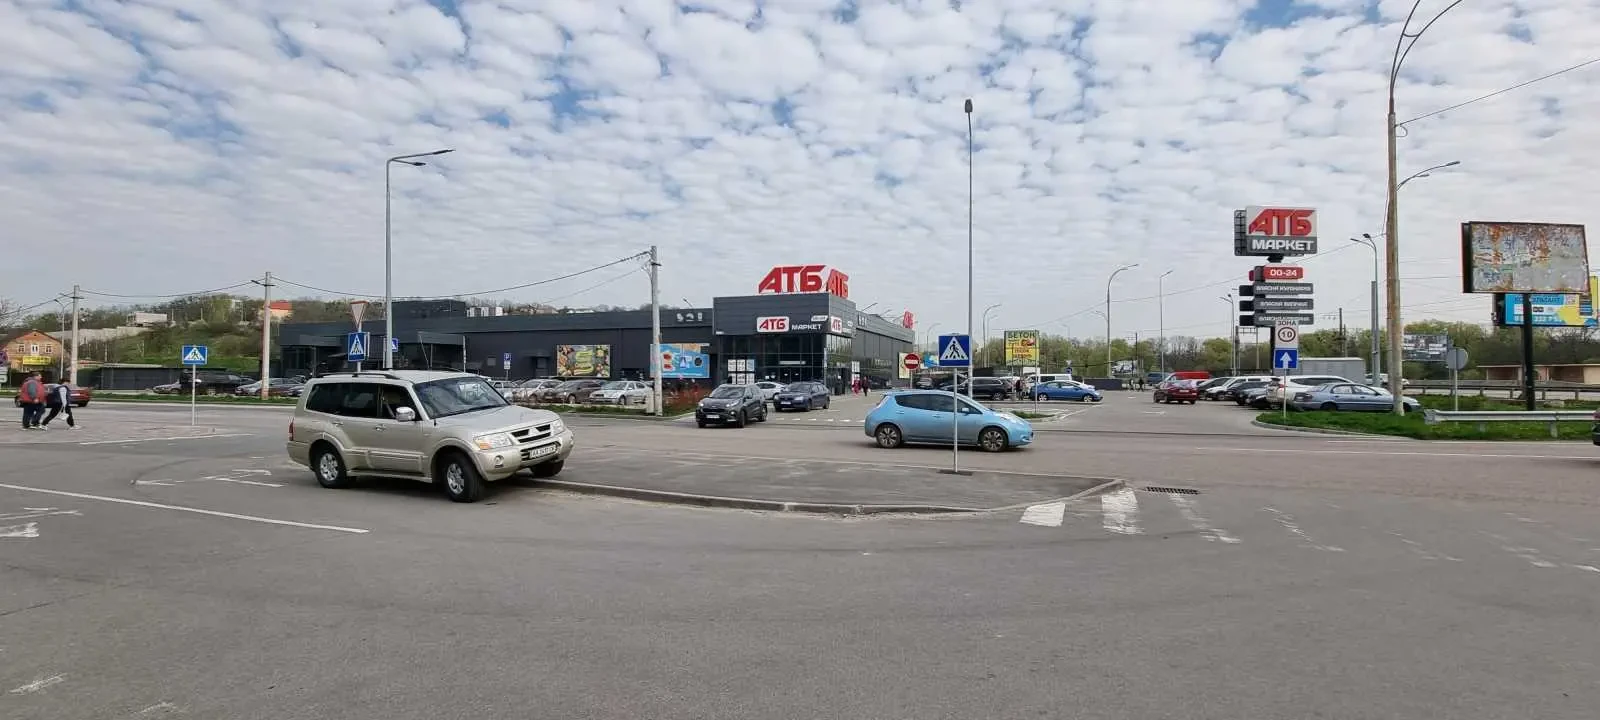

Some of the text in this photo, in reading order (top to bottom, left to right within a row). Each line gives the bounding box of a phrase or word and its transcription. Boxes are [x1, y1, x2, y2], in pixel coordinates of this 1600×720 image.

[1248, 208, 1316, 236] АТБ
[1252, 239, 1315, 251] МАРКЕТ
[759, 265, 825, 293] АТБ
[1269, 269, 1297, 277] 00-24
[827, 268, 849, 299] АТБ
[760, 318, 786, 330] АТБ
